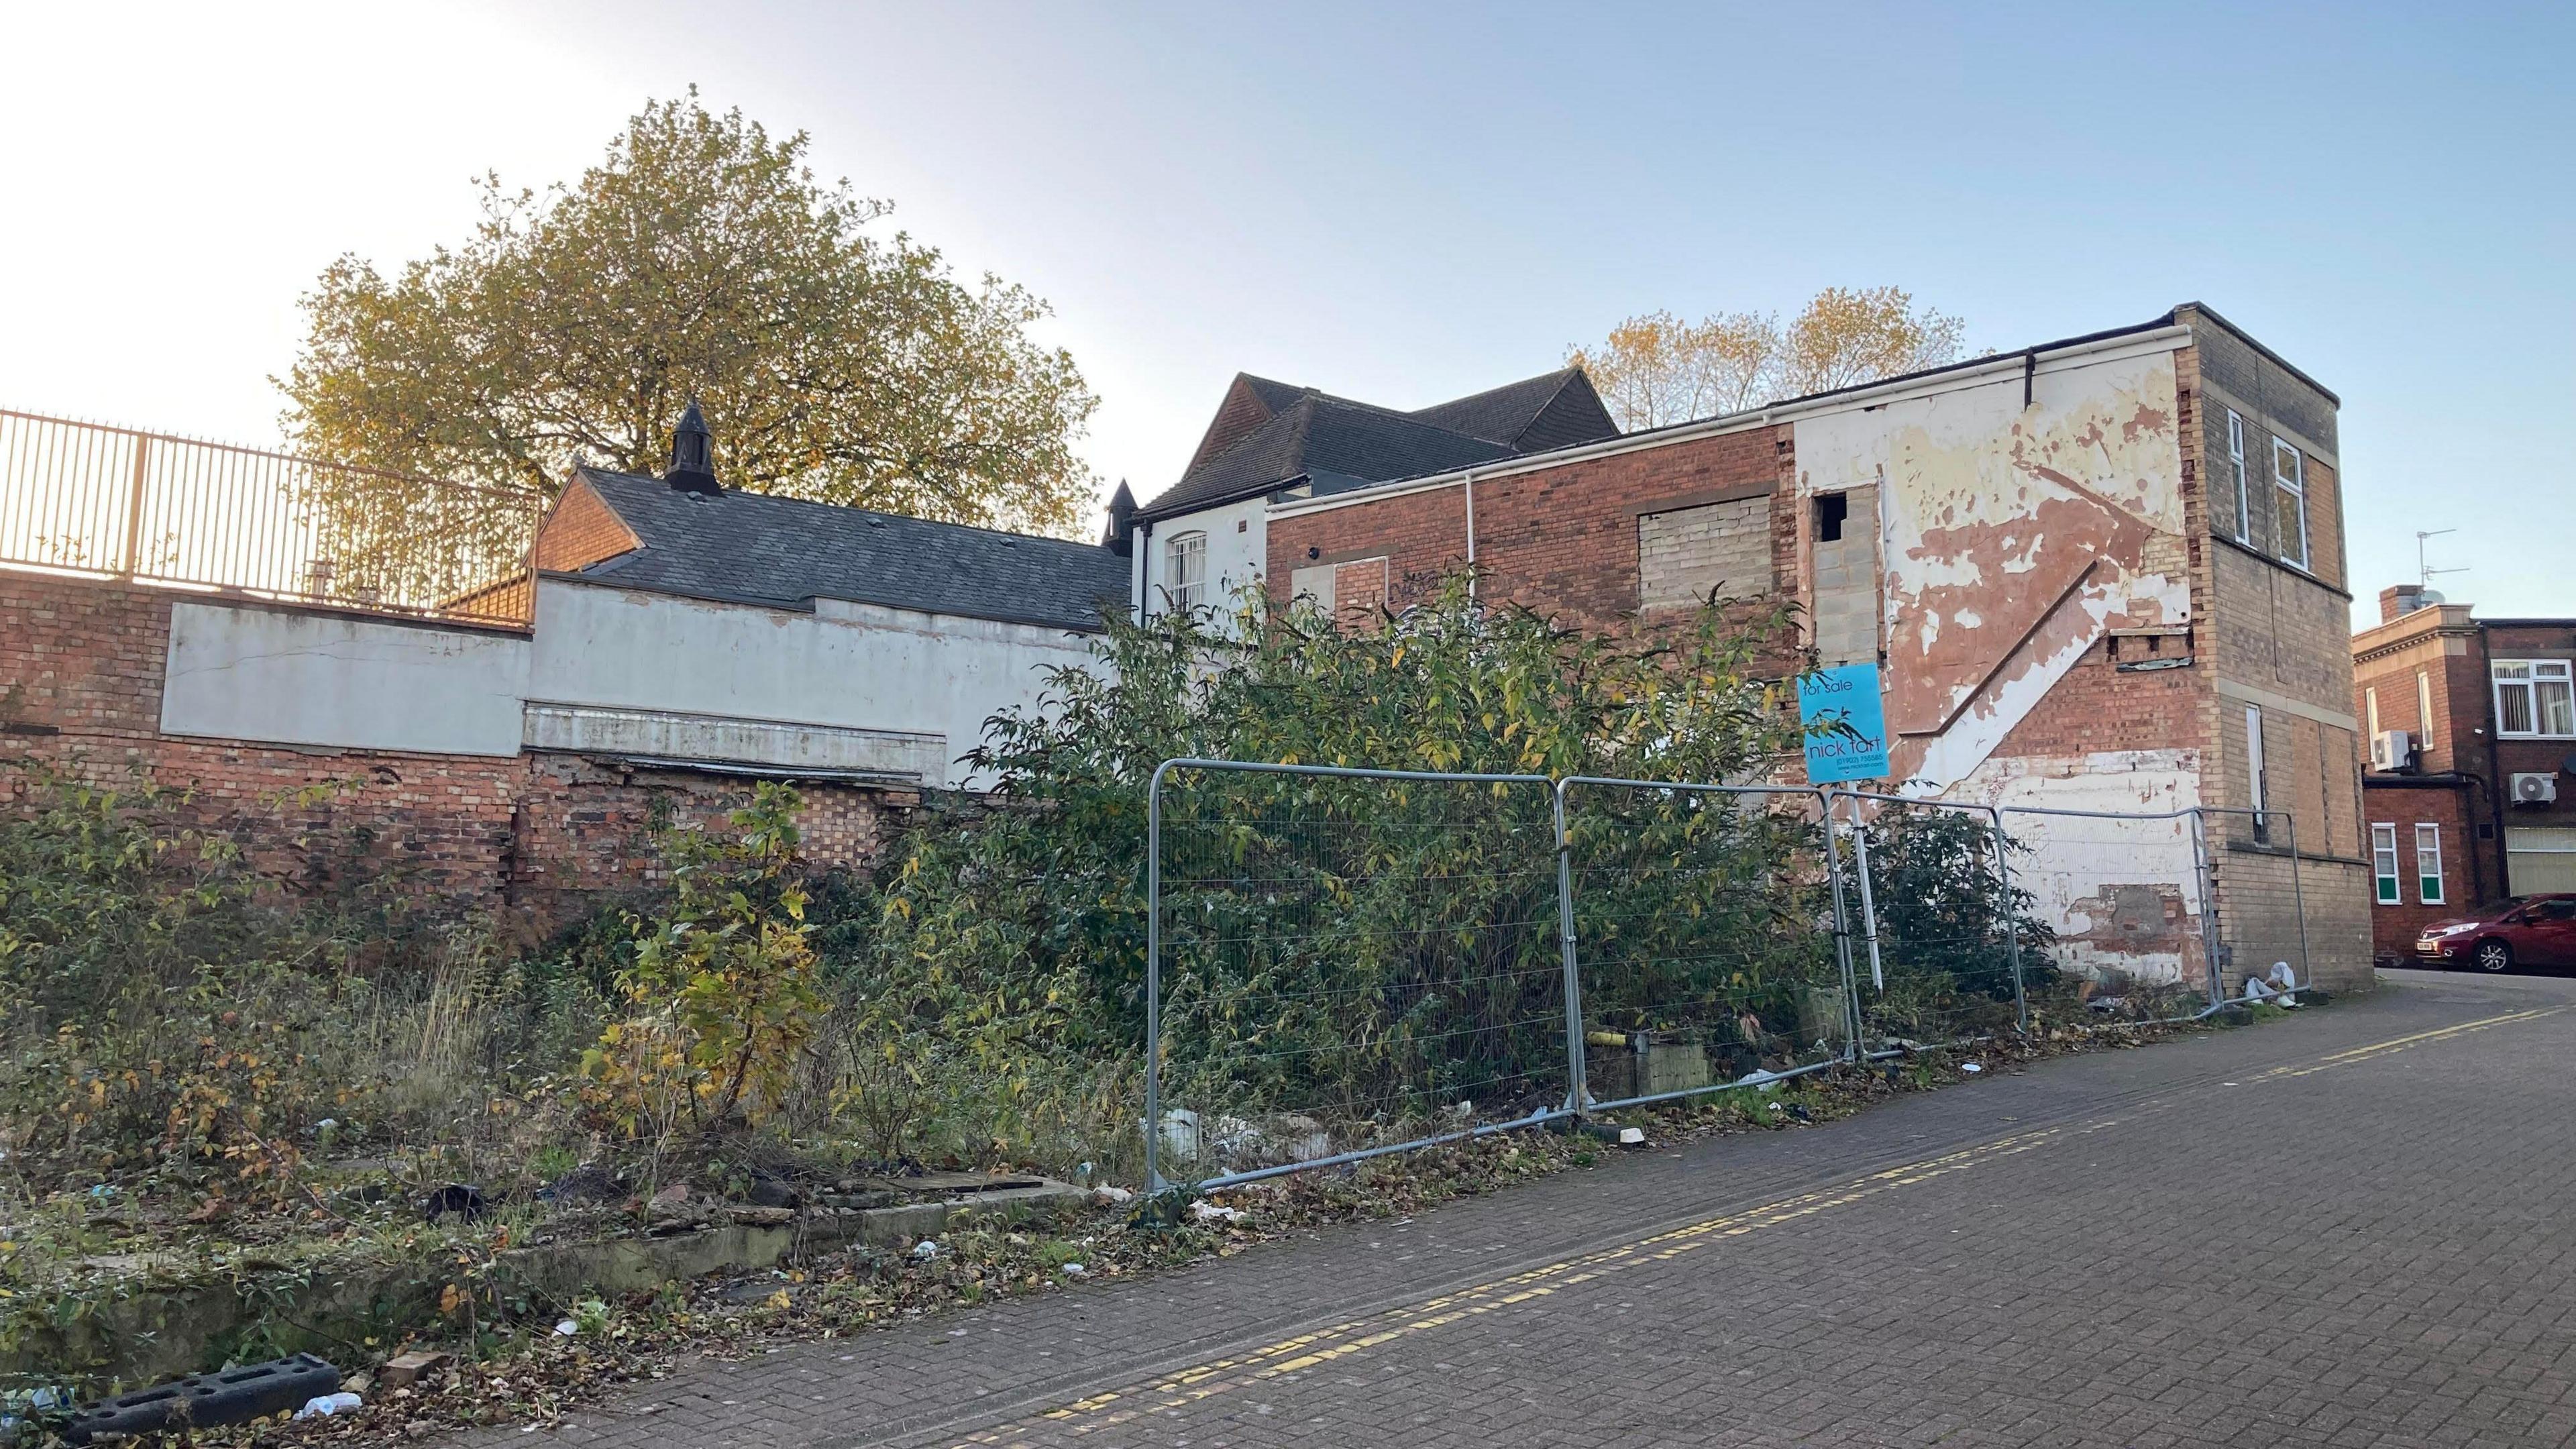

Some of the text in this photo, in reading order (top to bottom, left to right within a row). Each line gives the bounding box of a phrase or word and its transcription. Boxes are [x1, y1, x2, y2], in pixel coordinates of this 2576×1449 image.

[1803, 680, 1853, 696] for sale
[1809, 740, 1846, 759] nick
